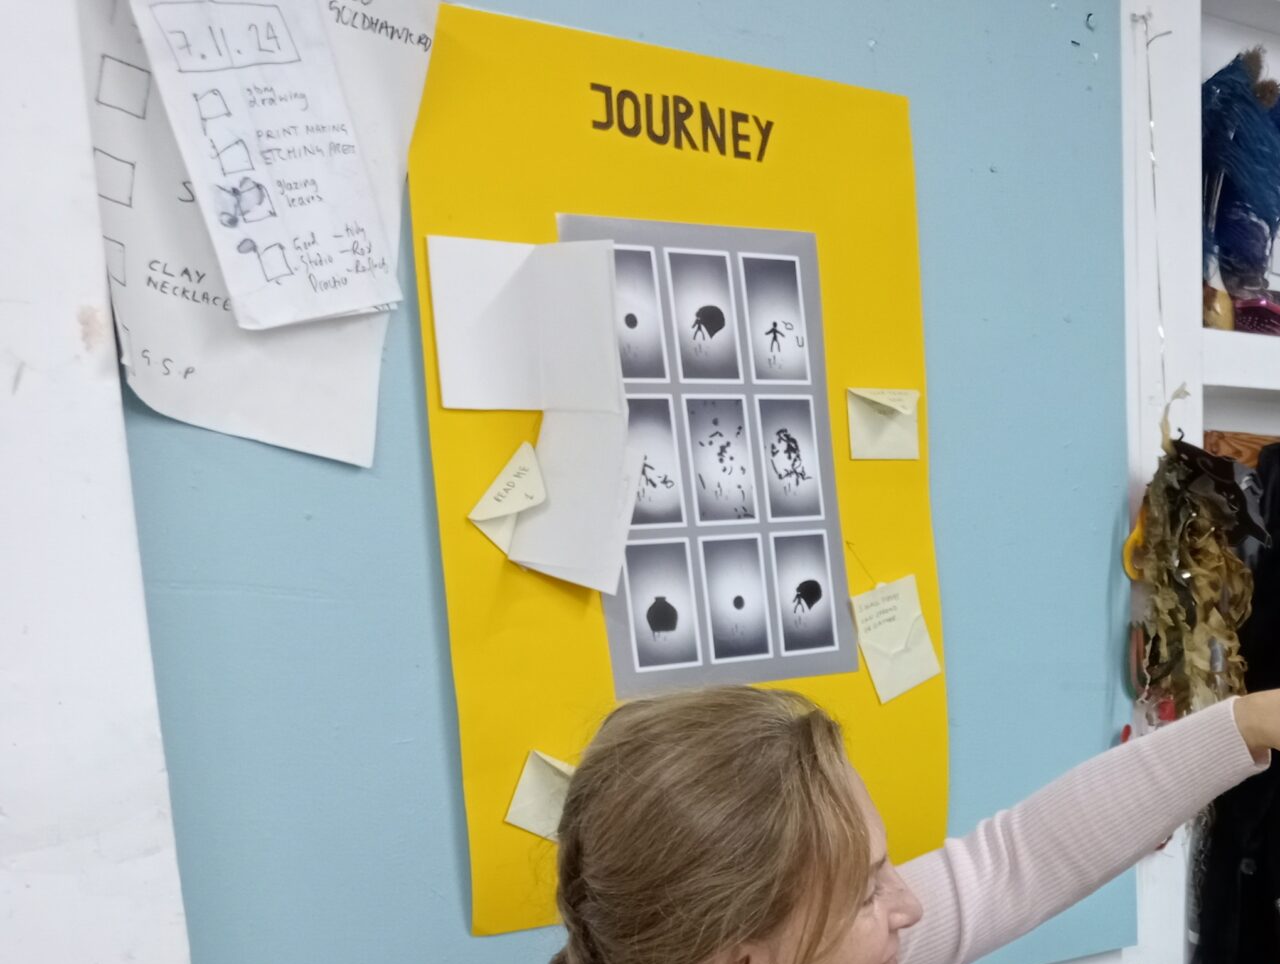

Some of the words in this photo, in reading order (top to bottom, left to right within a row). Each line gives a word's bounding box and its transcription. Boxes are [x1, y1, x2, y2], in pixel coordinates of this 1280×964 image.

[256, 125, 298, 139] PRINT
[589, 81, 775, 164] JOURNEY
[260, 144, 325, 166] ETCHING
[148, 258, 207, 285] CLAY
[493, 481, 516, 503] READ
[513, 465, 530, 479] ME
